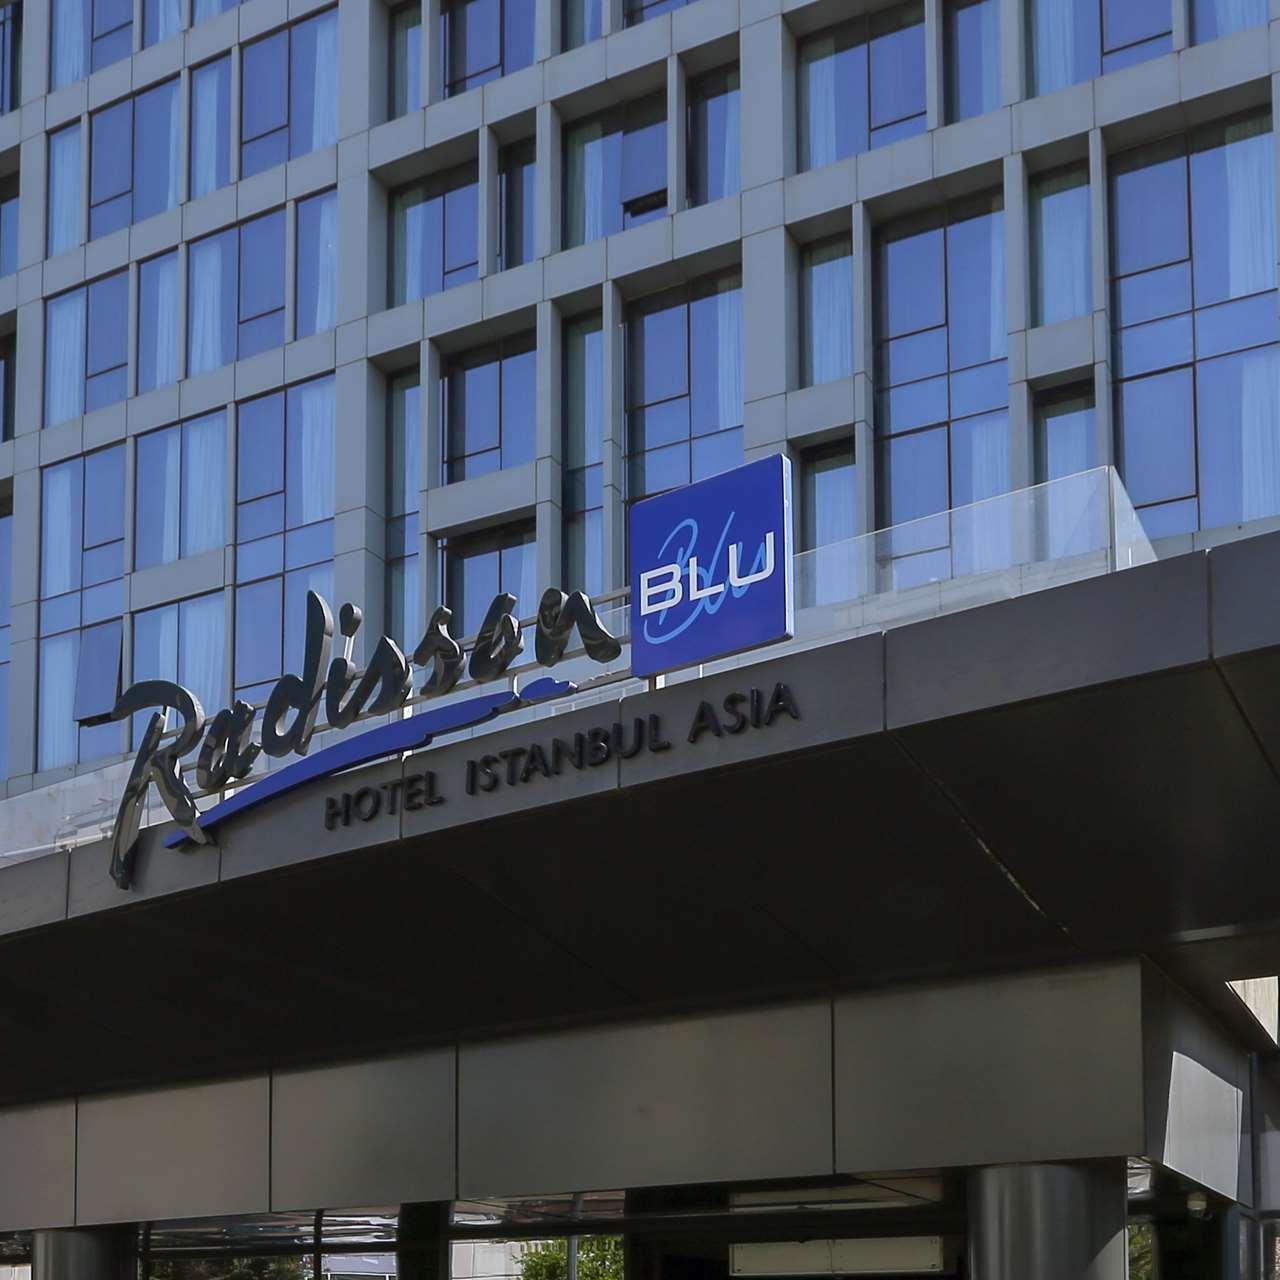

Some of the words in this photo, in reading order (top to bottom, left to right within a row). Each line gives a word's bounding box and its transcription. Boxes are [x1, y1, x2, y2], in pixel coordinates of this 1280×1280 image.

[639, 531, 776, 617] BLU
[109, 588, 623, 891] Radisson
[324, 769, 446, 831] HOTEL
[464, 713, 672, 797] ISTANBUL
[686, 681, 802, 744] ASIA
